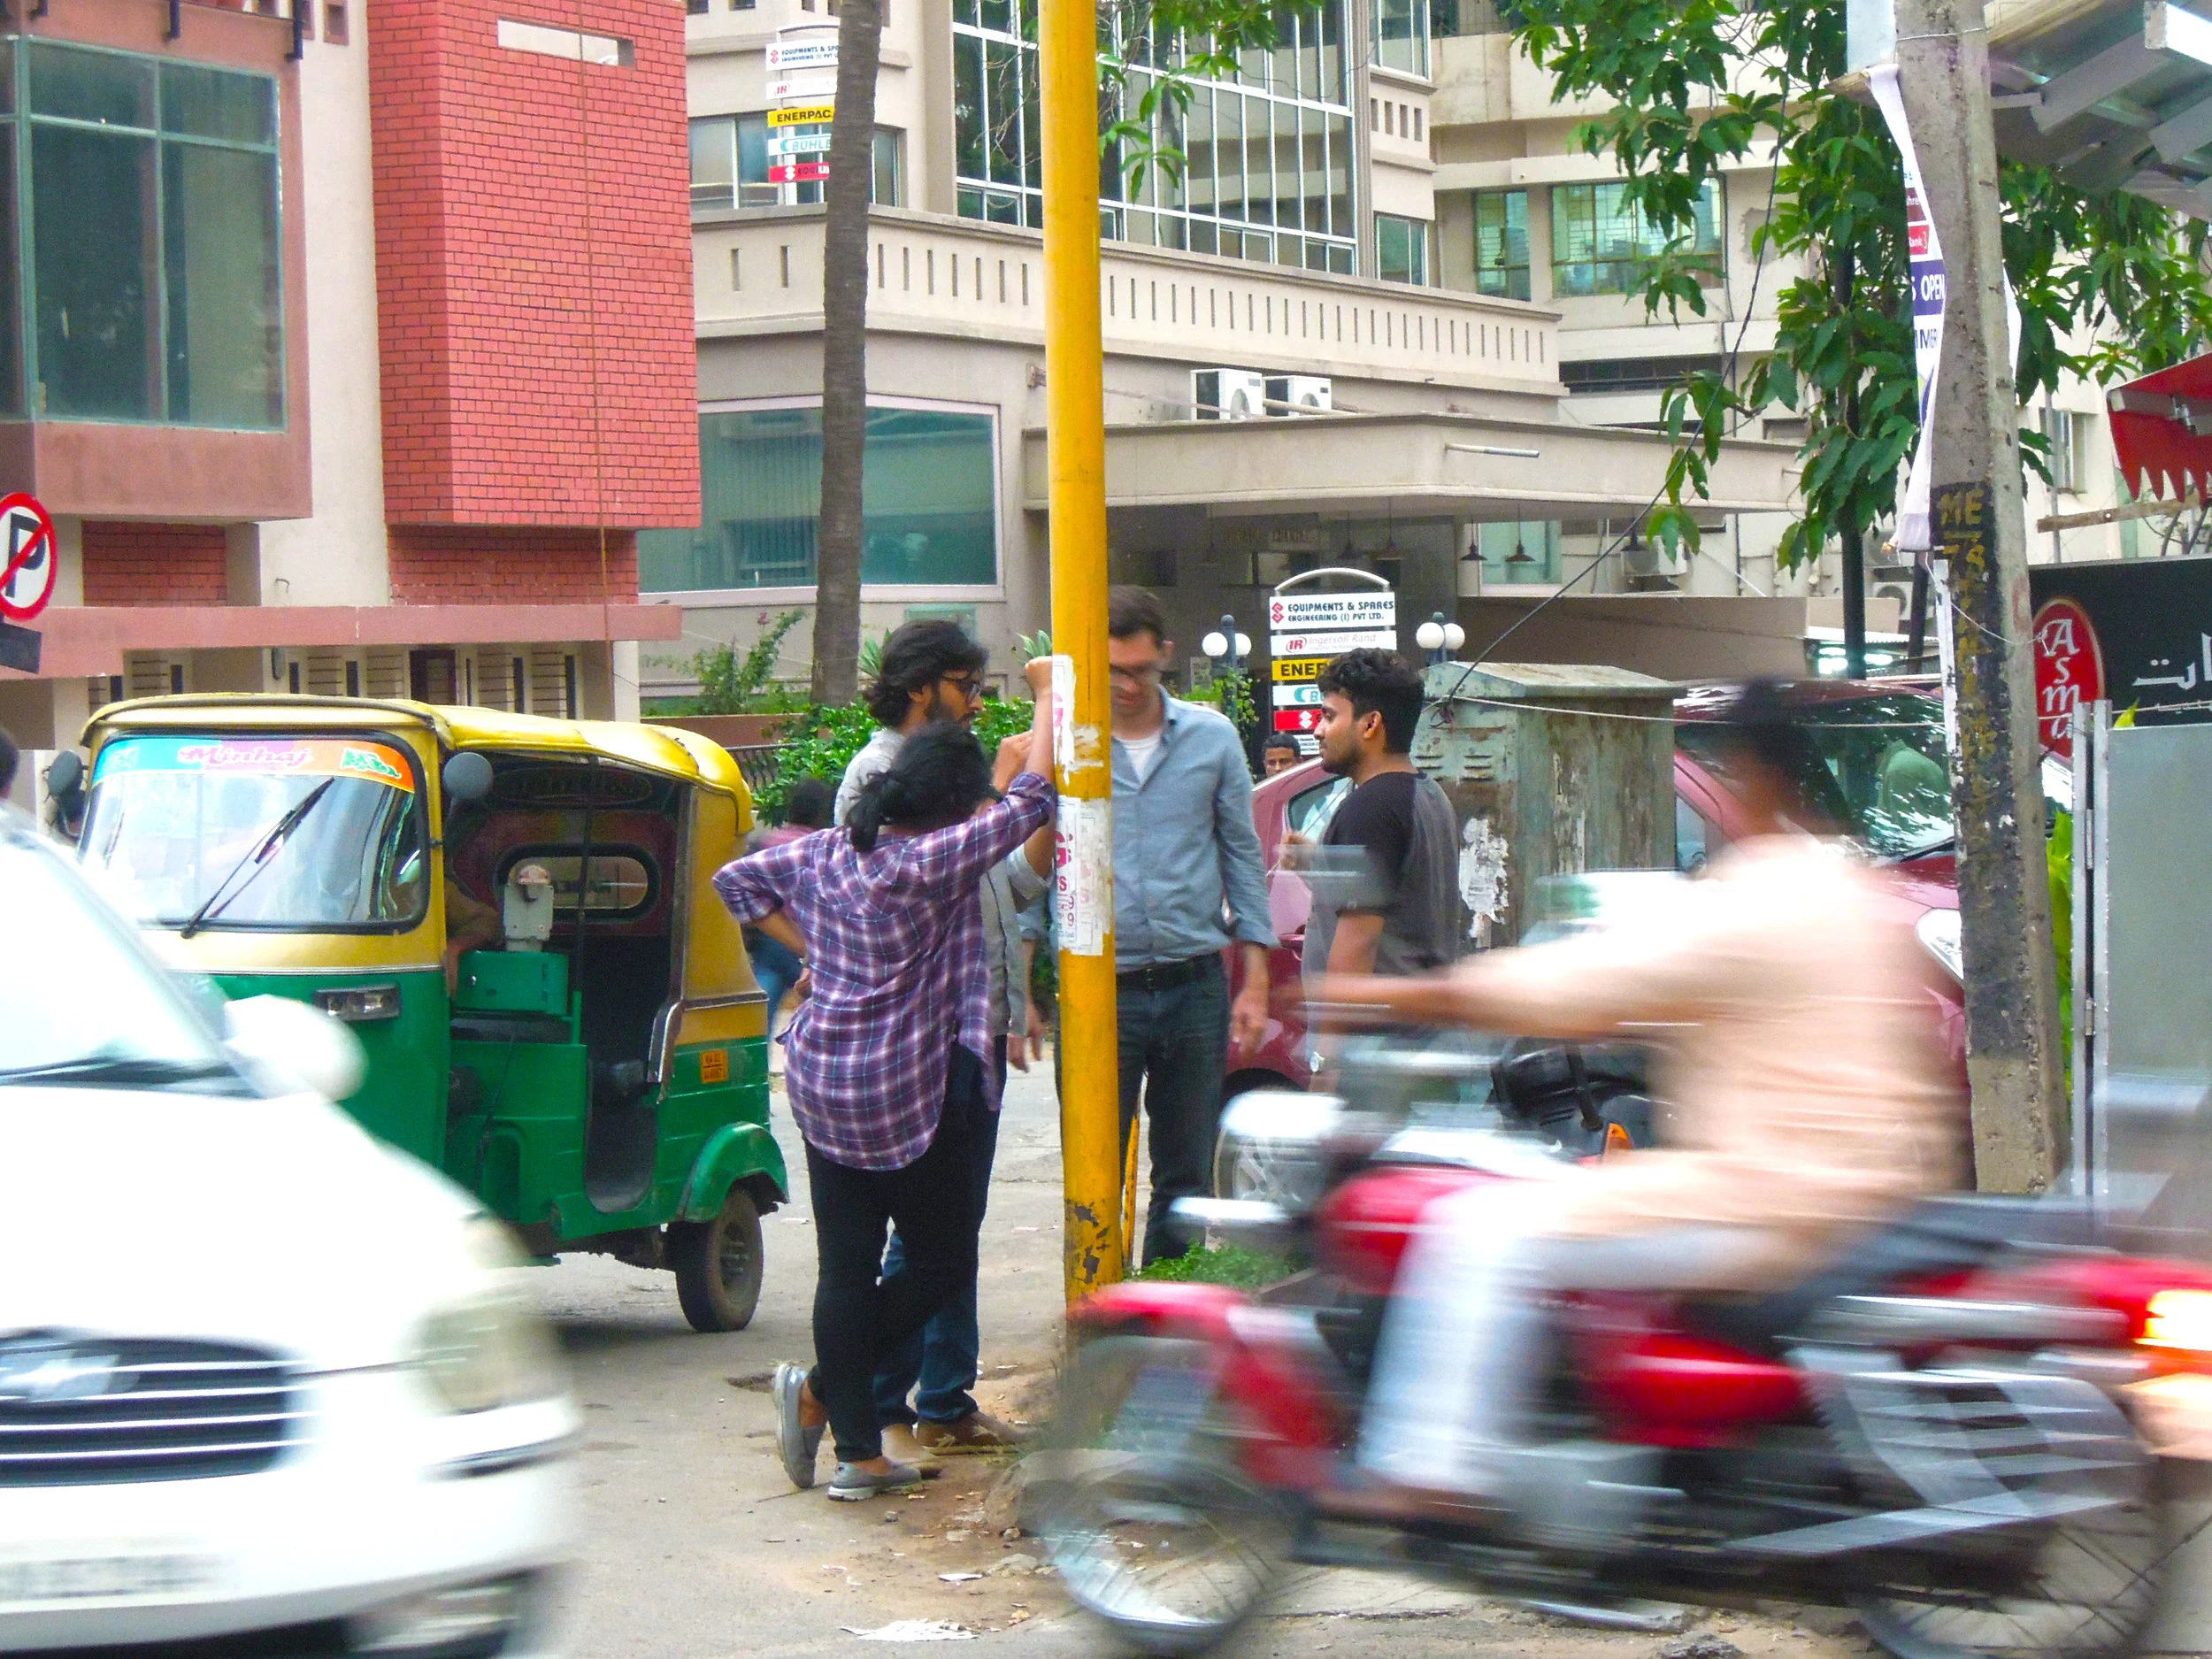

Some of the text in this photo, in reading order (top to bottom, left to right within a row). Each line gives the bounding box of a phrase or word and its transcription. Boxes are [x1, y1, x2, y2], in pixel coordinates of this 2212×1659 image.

[777, 109, 832, 122] ENERPAC
[1921, 273, 1945, 302] OPEN
[1287, 601, 1394, 612] EQUIPMENTS & SPARES
[1289, 640, 1303, 650] IR
[1309, 635, 1349, 645] Ingersoll
[1352, 634, 1377, 642] Rand
[180, 747, 311, 767] Minhaj
